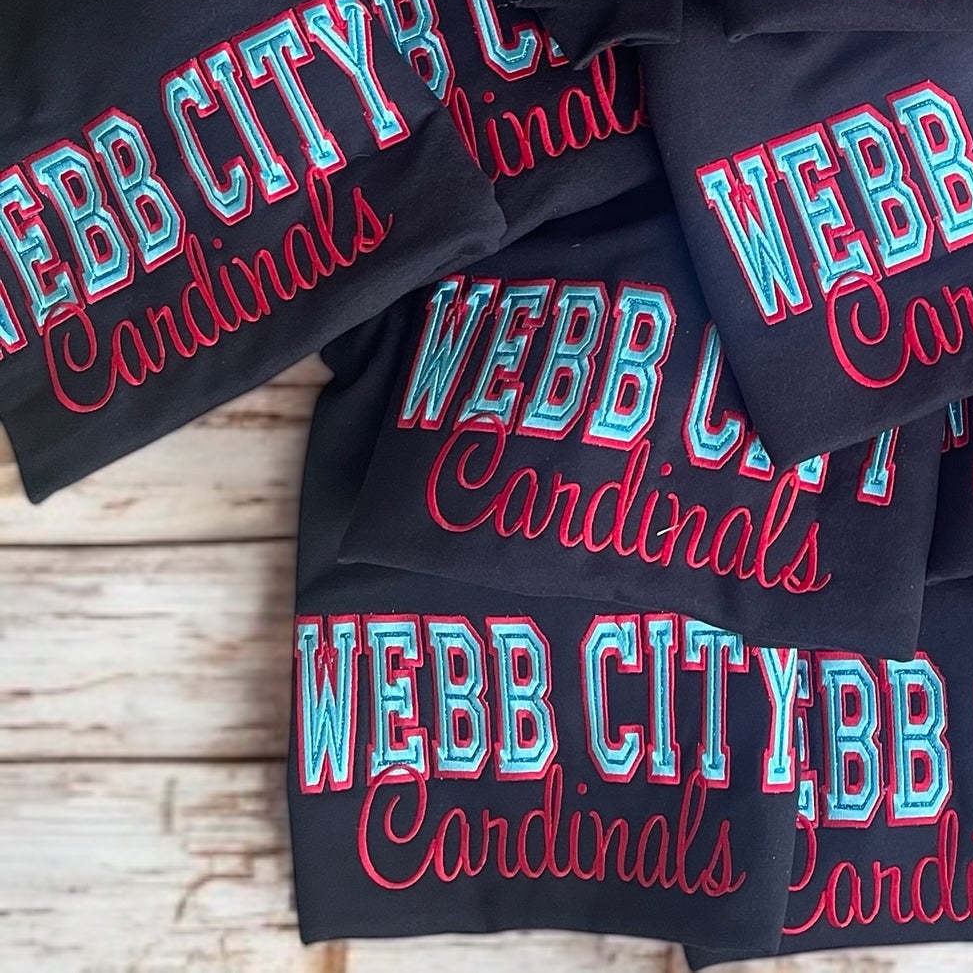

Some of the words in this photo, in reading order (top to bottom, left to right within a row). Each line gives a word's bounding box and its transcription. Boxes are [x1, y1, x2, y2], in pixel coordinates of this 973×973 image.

[0, 106, 187, 361] EBB
[39, 167, 394, 414] Cardinals
[396, 275, 677, 451] WEBB
[425, 413, 832, 594] Cardinals
[295, 614, 559, 794] WEBB
[579, 613, 798, 794] CITY
[356, 763, 747, 897] Cardinals
